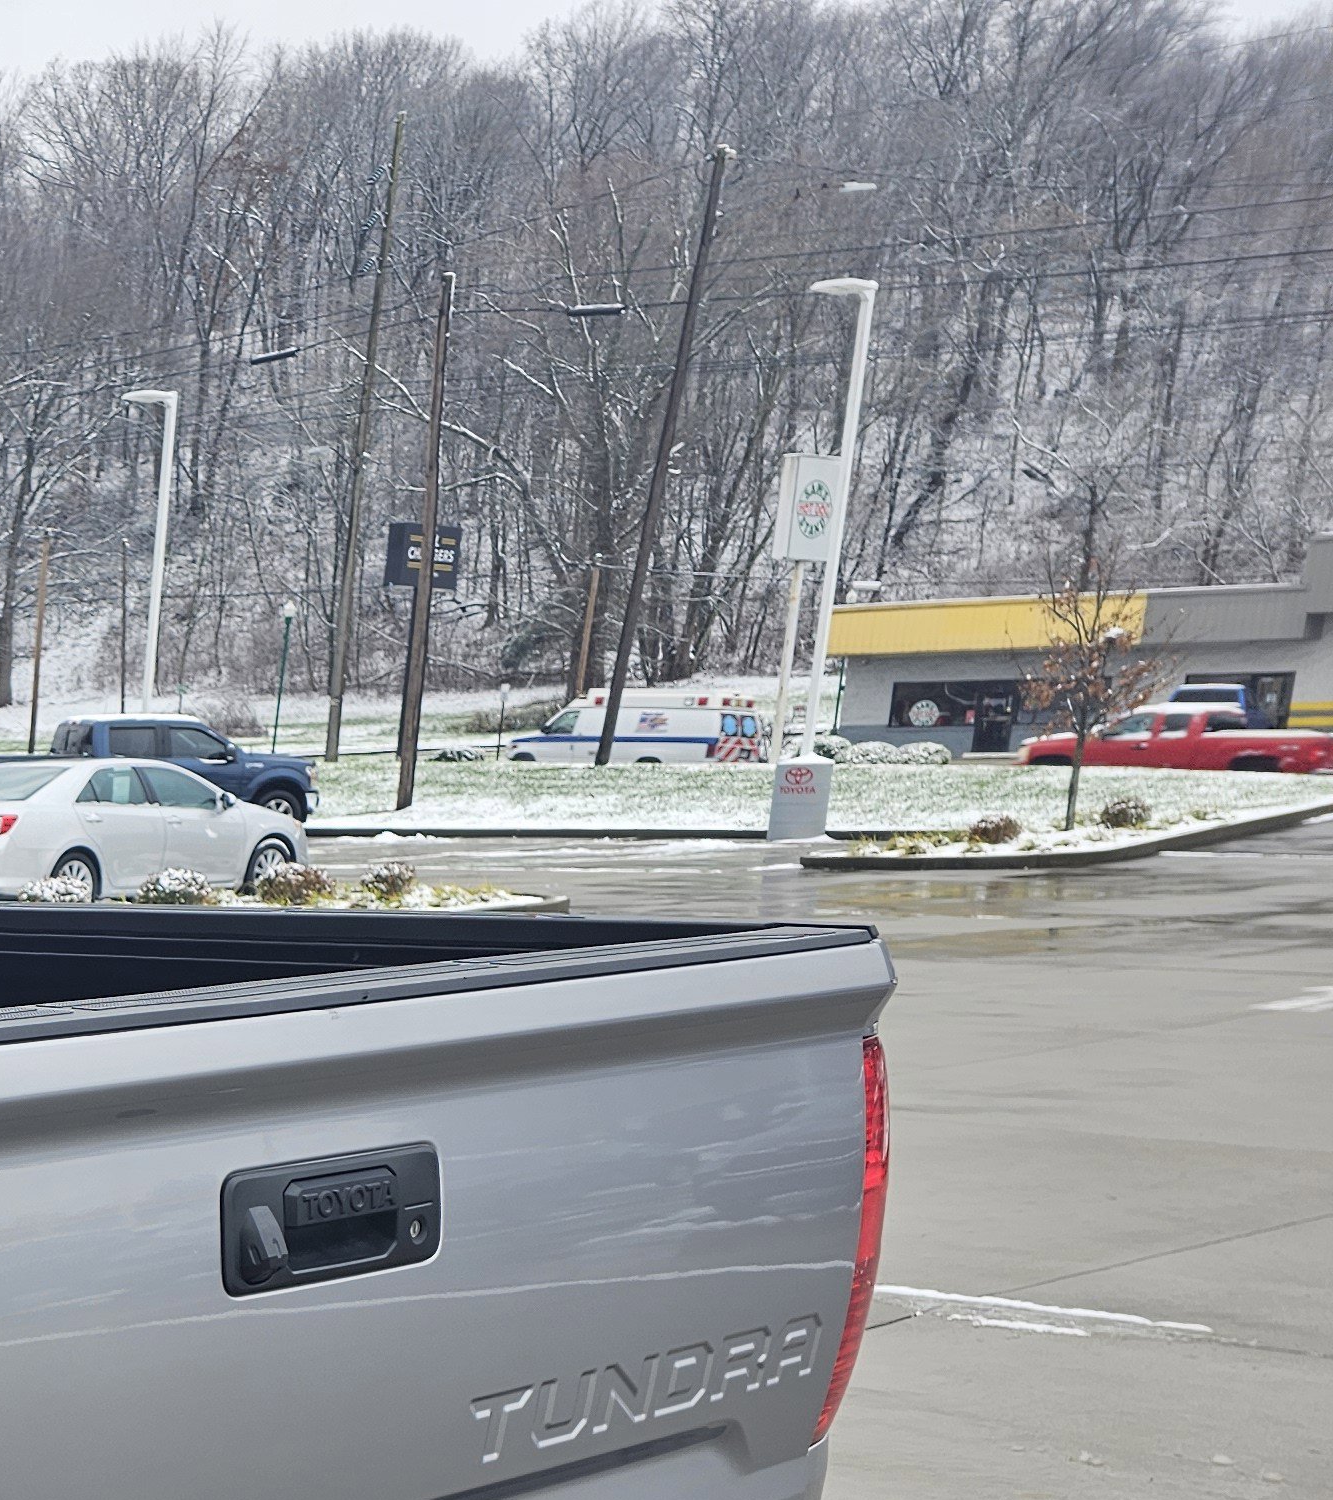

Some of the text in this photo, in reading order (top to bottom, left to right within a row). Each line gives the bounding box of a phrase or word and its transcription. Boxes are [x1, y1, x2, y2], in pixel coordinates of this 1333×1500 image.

[779, 786, 816, 795] TOYOTA
[301, 1180, 395, 1221] TOYOTA
[470, 1312, 823, 1464] TUNDRA
